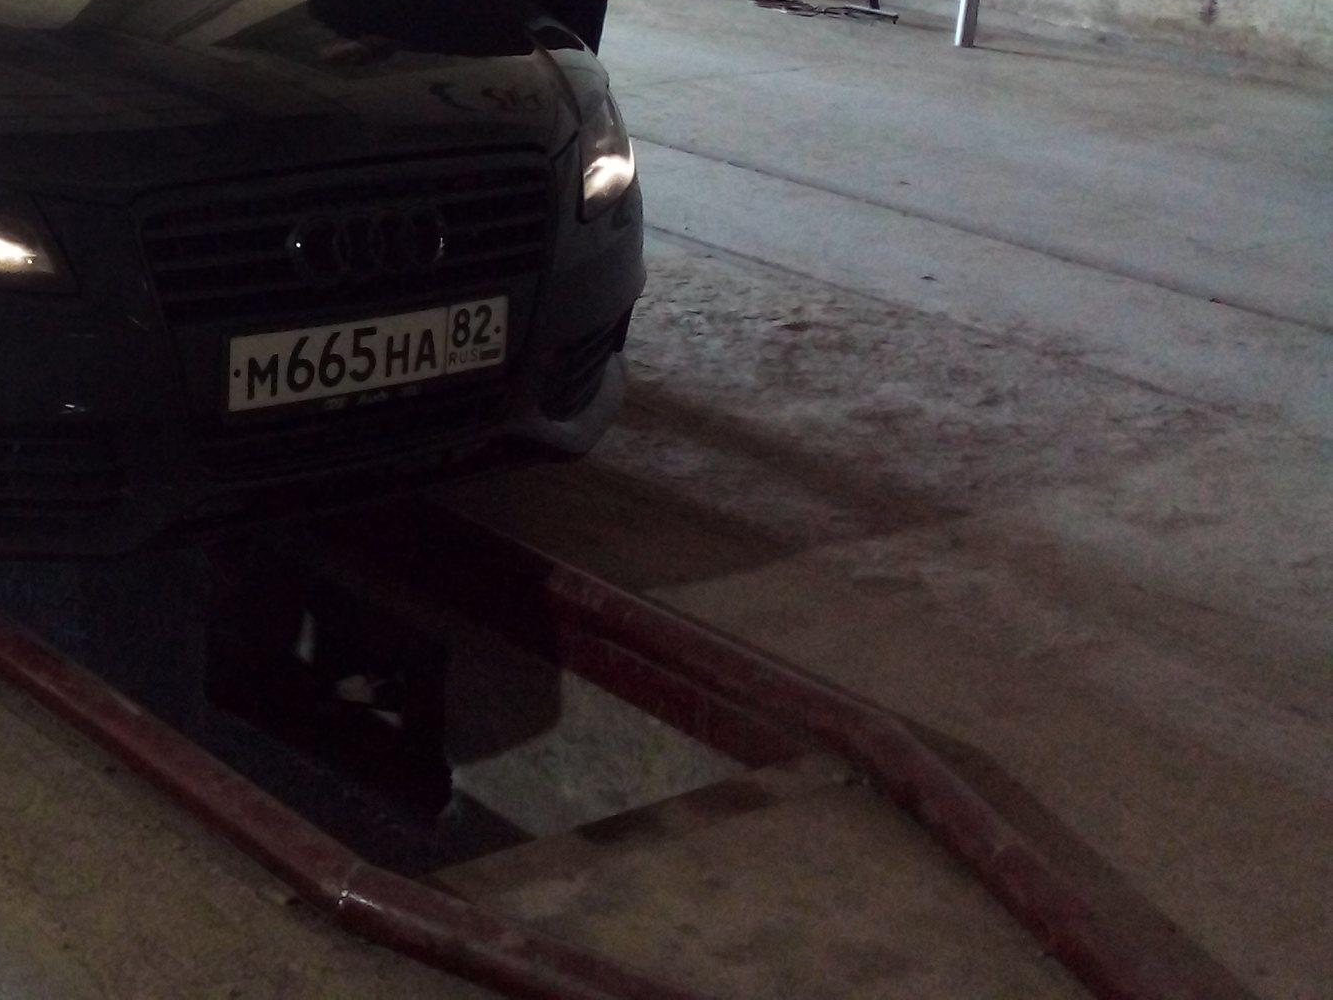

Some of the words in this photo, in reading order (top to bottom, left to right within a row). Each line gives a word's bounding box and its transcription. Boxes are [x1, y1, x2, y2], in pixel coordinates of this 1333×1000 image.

[247, 326, 437, 400] М665НА
[451, 304, 493, 348] 82
[447, 349, 479, 366] RUS
